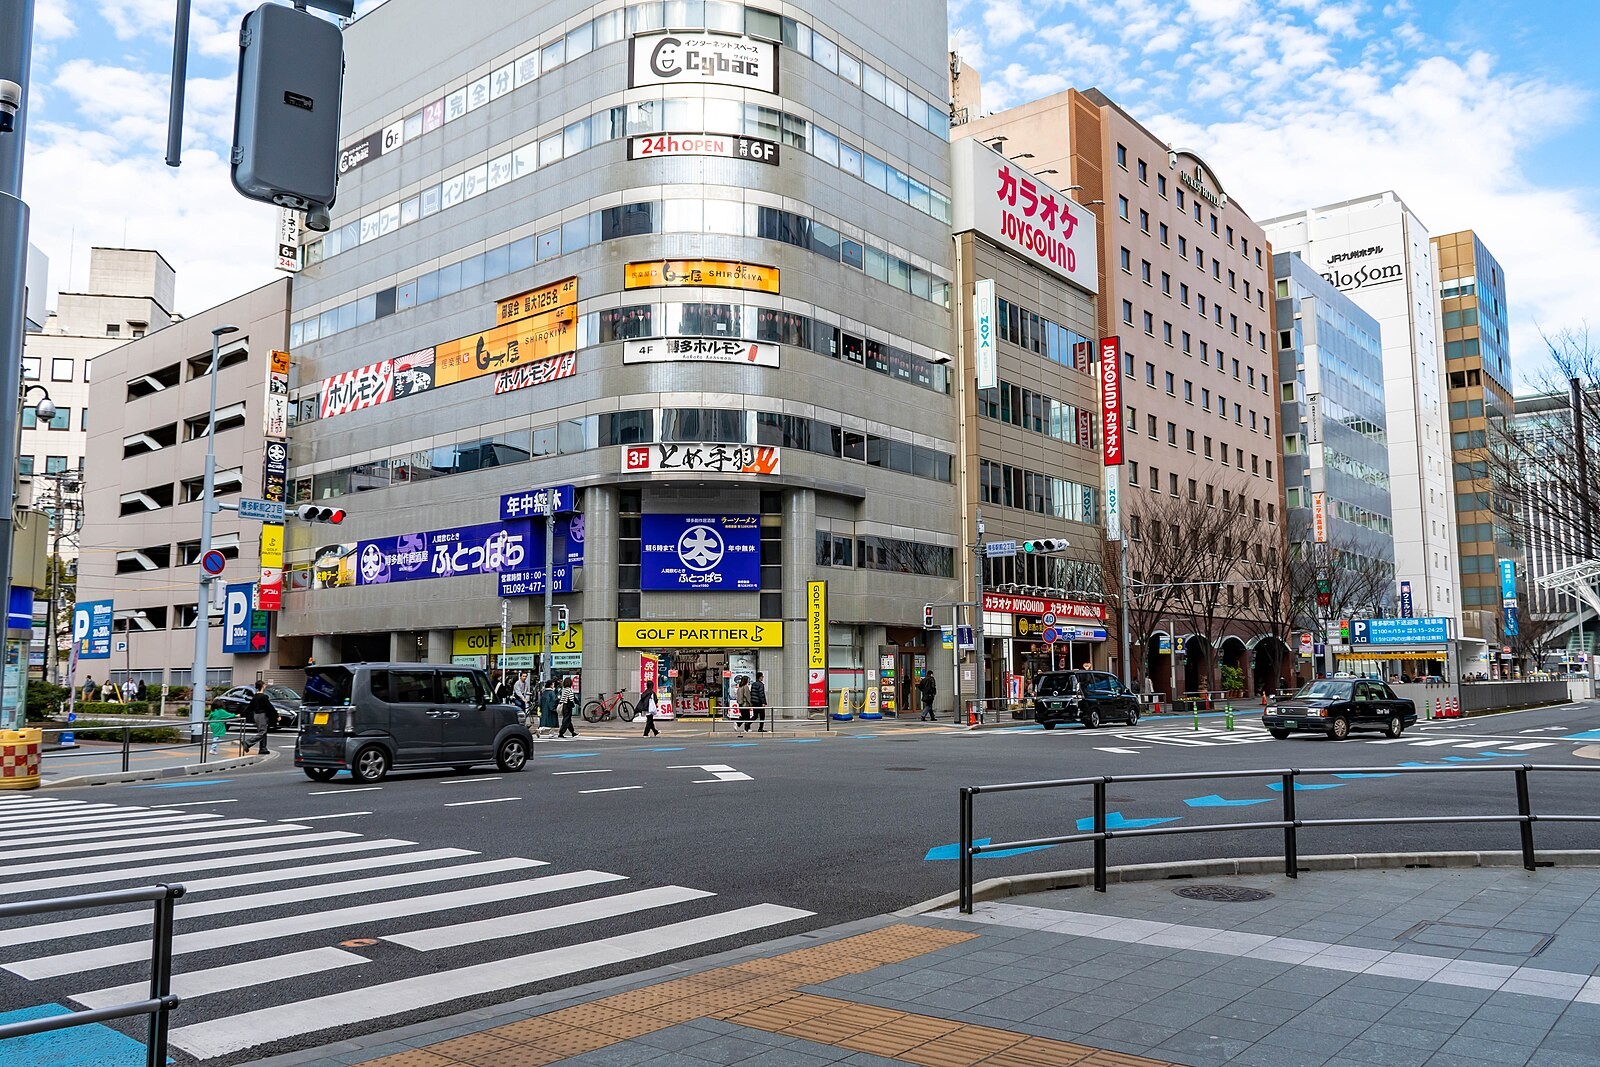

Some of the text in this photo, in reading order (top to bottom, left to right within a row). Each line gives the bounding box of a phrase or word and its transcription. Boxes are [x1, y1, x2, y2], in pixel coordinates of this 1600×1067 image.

[686, 51, 758, 77] Cybac
[385, 130, 399, 149] 6F
[641, 136, 724, 154] 24h OPEN
[750, 142, 774, 160] 6F
[444, 155, 525, 199] インターネット
[996, 165, 1079, 240] カラオケ
[362, 212, 398, 239] シャワー
[1000, 210, 1077, 273] JOYSOUND
[281, 247, 293, 257] 6F
[1327, 245, 1384, 264] JR九州ホテル
[280, 258, 295, 268] 24h
[708, 270, 763, 282] SHIROKIYA
[562, 281, 574, 292] 4F
[524, 288, 558, 313] 最大125名
[555, 308, 565, 318] 4F
[525, 326, 567, 345] SHIROKIYA
[980, 315, 990, 348] NOVA
[638, 346, 654, 354] 4F
[666, 339, 746, 355] 博多ホルモン
[560, 359, 572, 371] 4F
[500, 362, 556, 389] ホルモン
[1103, 345, 1117, 409] JOYSOUND
[328, 374, 385, 409] ホルモン
[1105, 411, 1119, 458] カラオケ
[628, 451, 648, 466] 3F
[241, 501, 283, 514] 博多駅前2丁目
[1108, 488, 1117, 514] NOVA
[727, 544, 756, 552] 年中無休
[985, 596, 1101, 618] カラオケ JOYSOUND カラオケ JOYSOUND
[75, 610, 90, 643] P
[226, 592, 248, 646] P
[1045, 615, 1054, 623] 40
[1354, 622, 1366, 635] P
[467, 634, 498, 648] GOLF
[636, 629, 748, 640] GOLF PARTNER
[813, 611, 821, 655] PARTNER
[118, 642, 126, 650] P
